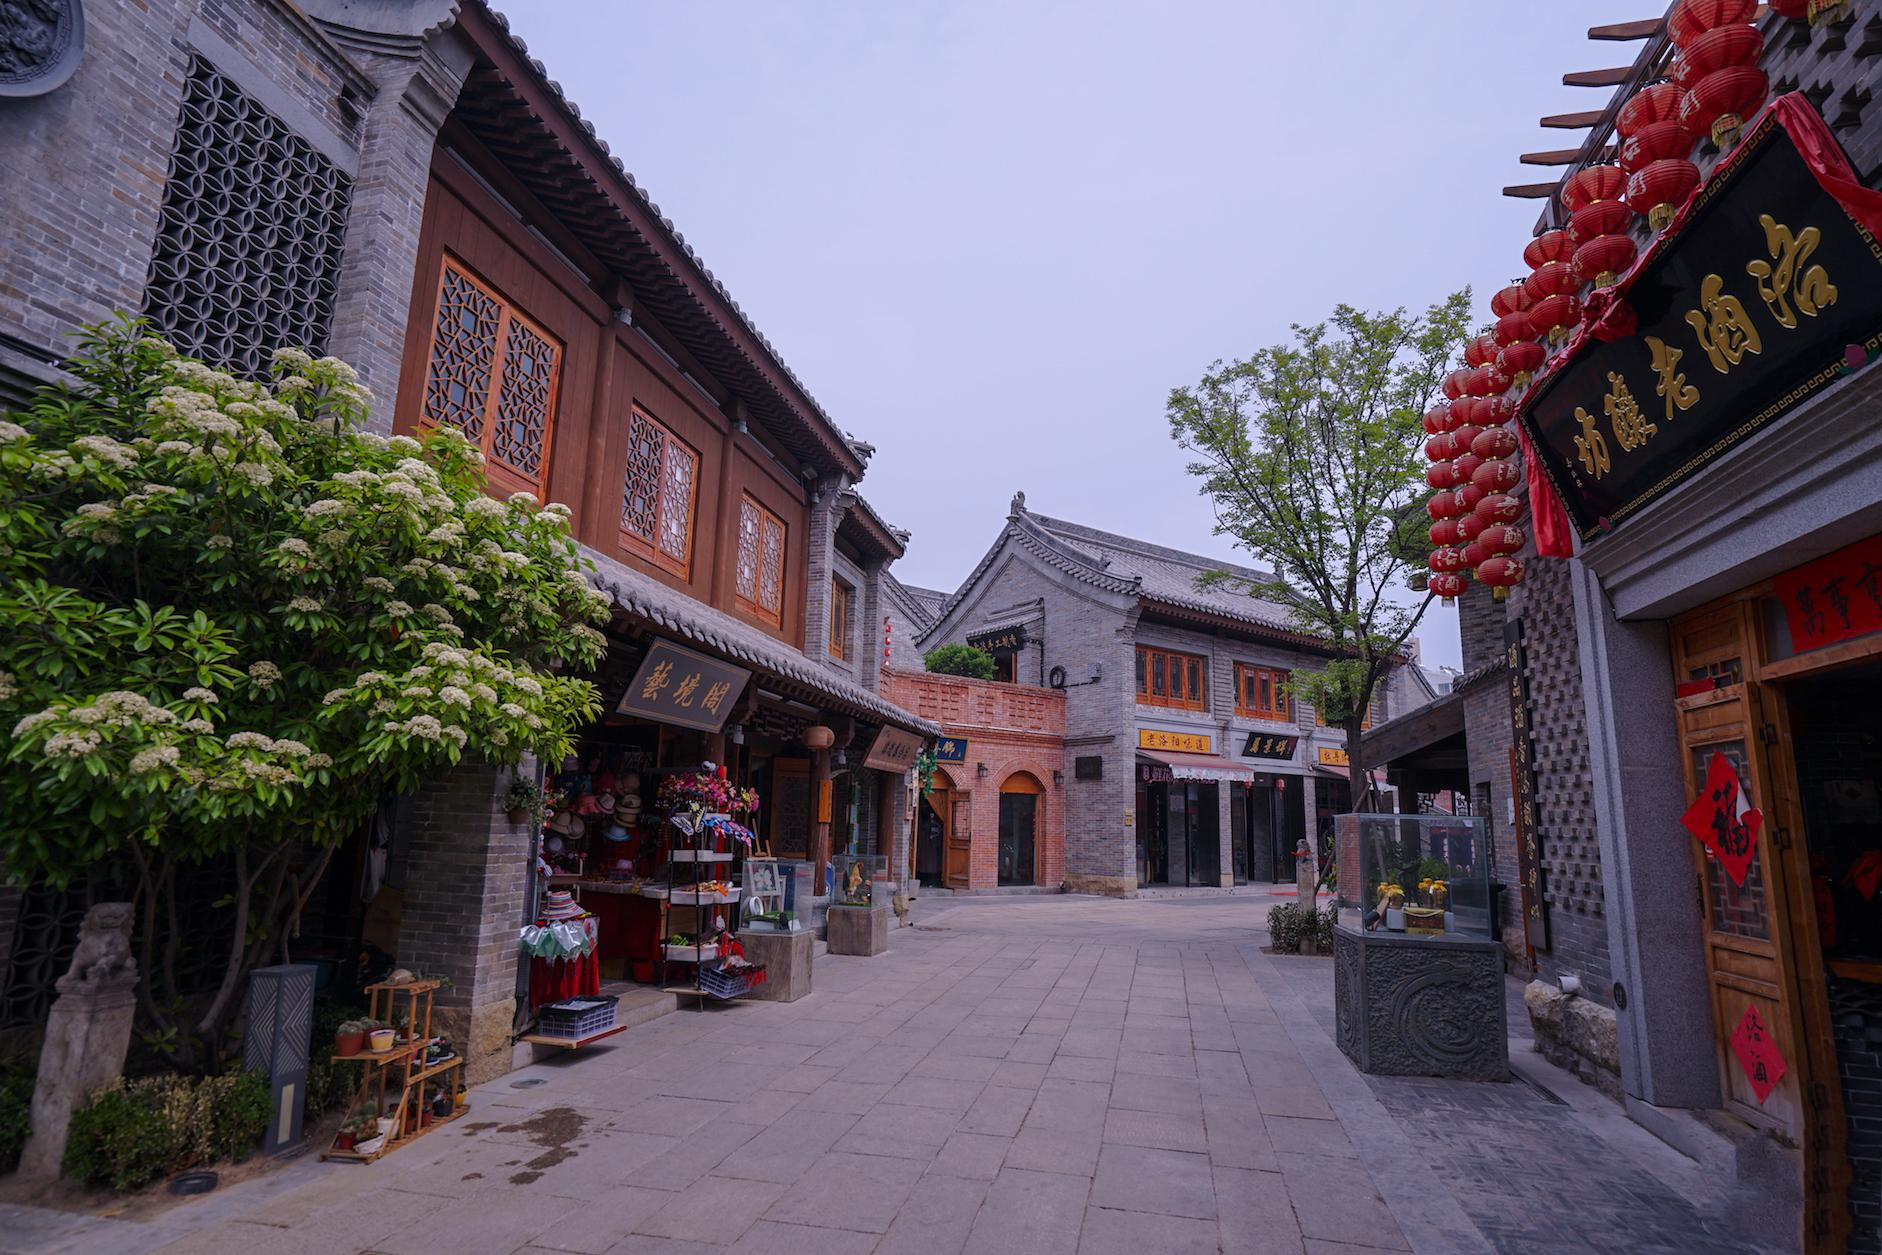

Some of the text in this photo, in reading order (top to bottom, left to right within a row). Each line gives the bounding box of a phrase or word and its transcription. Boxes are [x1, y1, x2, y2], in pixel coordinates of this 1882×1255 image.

[1147, 732, 1205, 751] 老洛阳味道
[1711, 781, 1750, 857] 福
